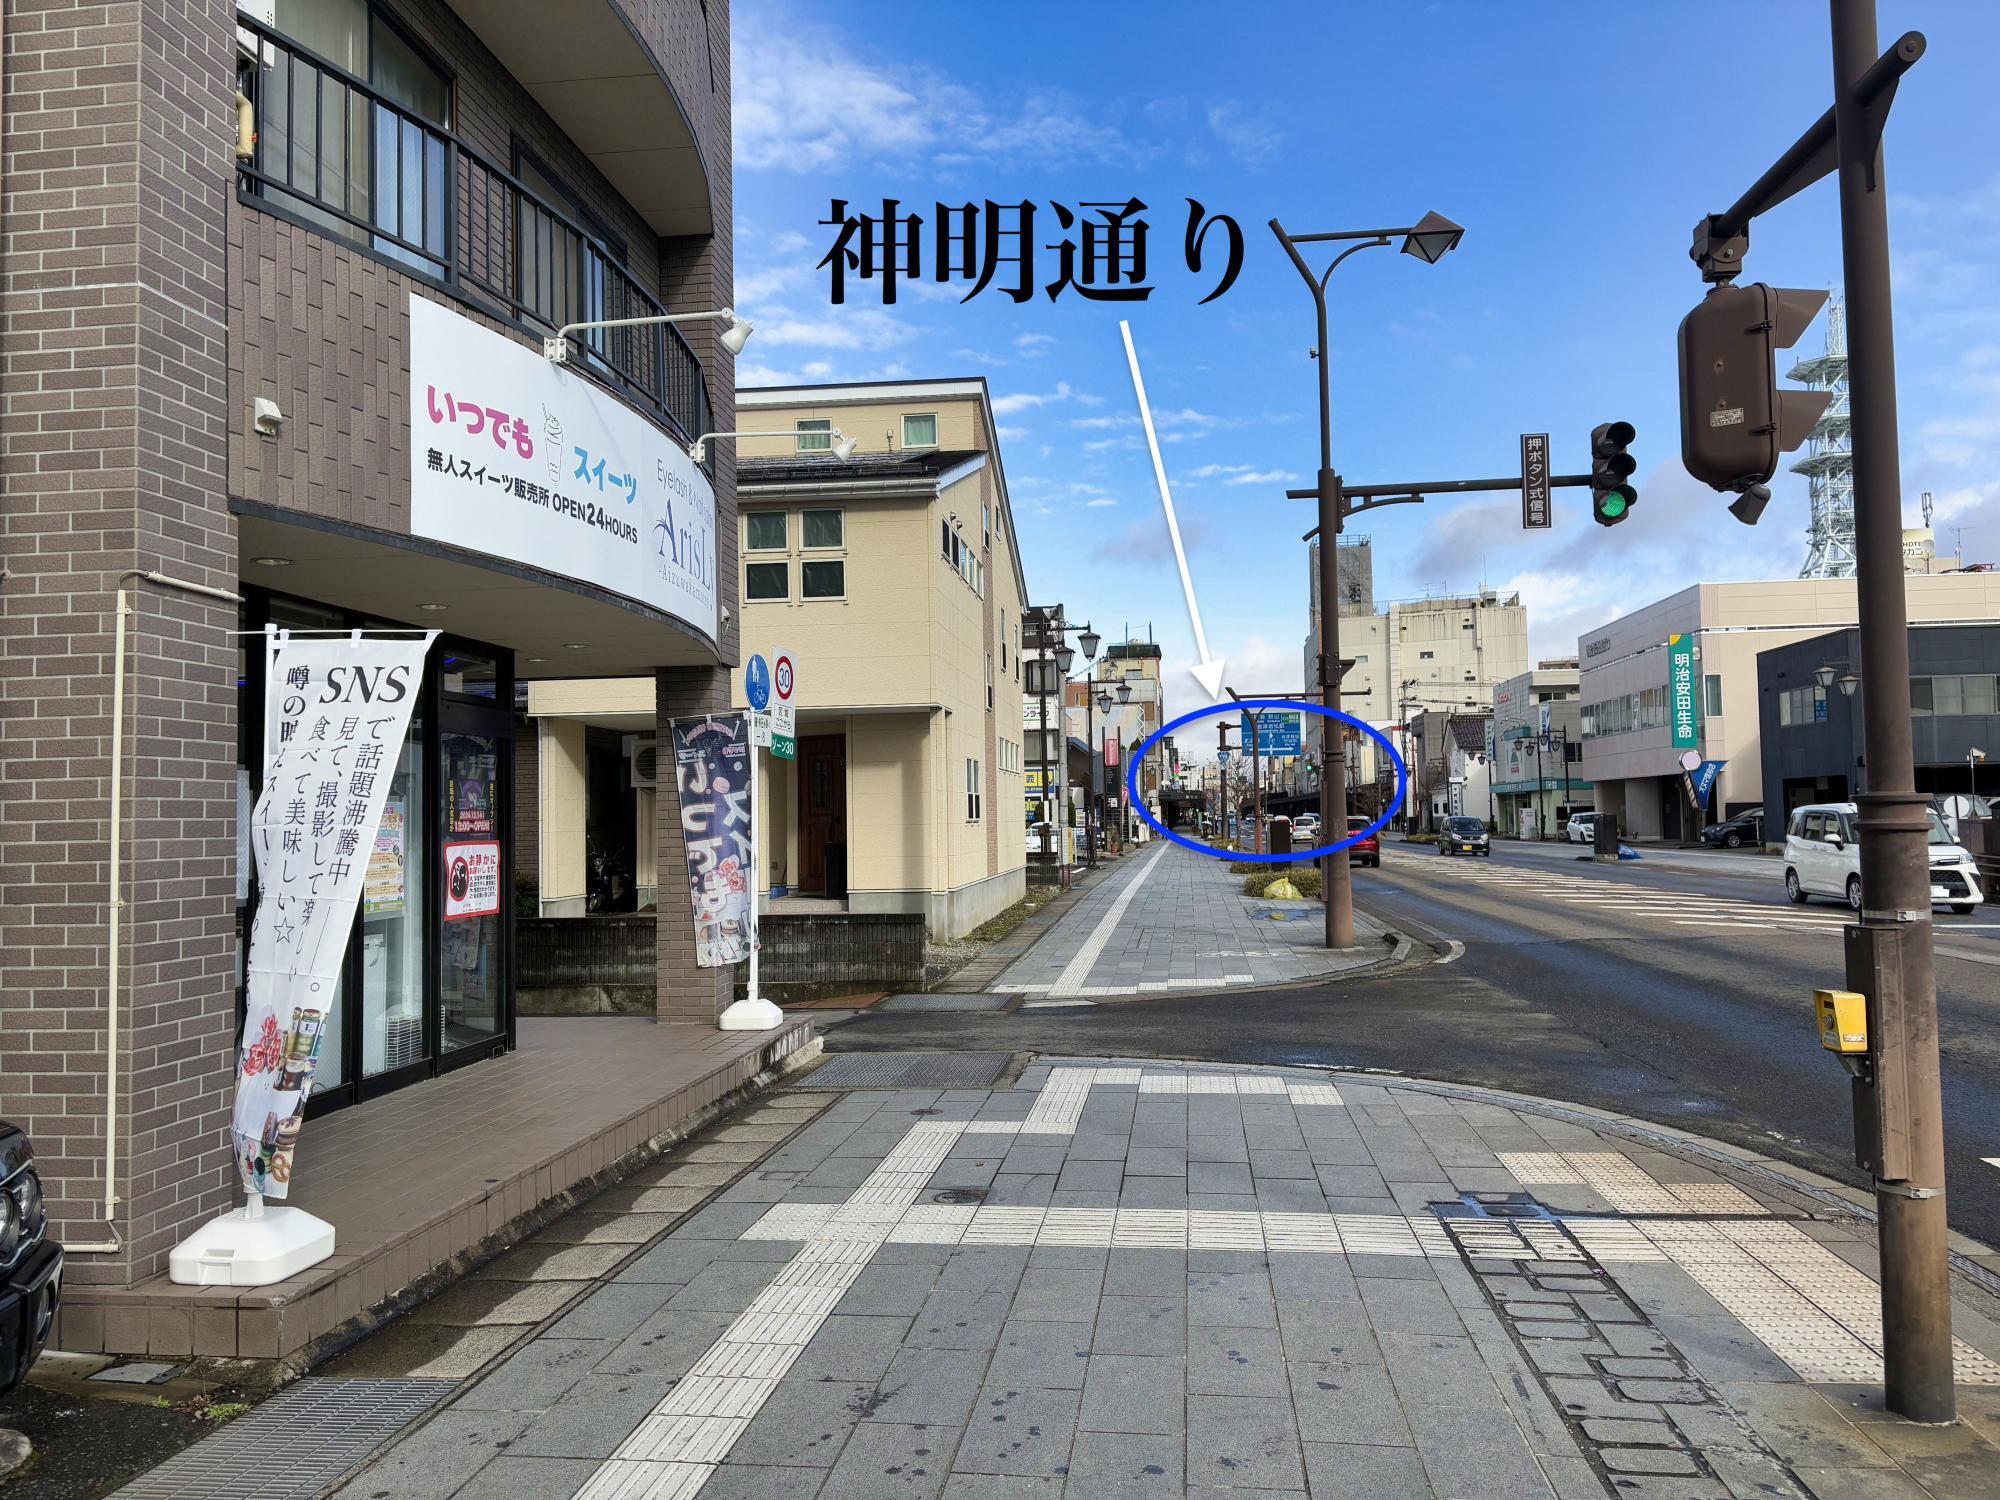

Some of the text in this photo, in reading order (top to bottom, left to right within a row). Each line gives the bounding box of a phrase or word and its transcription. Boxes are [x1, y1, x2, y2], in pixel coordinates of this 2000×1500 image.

[427, 384, 534, 460] いつでも
[427, 447, 550, 509] 無人スイーツ販売所
[574, 445, 637, 505] スイーツ
[657, 458, 688, 500] Eyelash
[1527, 438, 1544, 524] 押ボタン式信号
[319, 665, 409, 704] SNS
[779, 667, 790, 689] 30
[1674, 653, 1693, 739] 明治安田生命
[771, 738, 794, 756] ゾーン30
[775, 716, 791, 730] ここから
